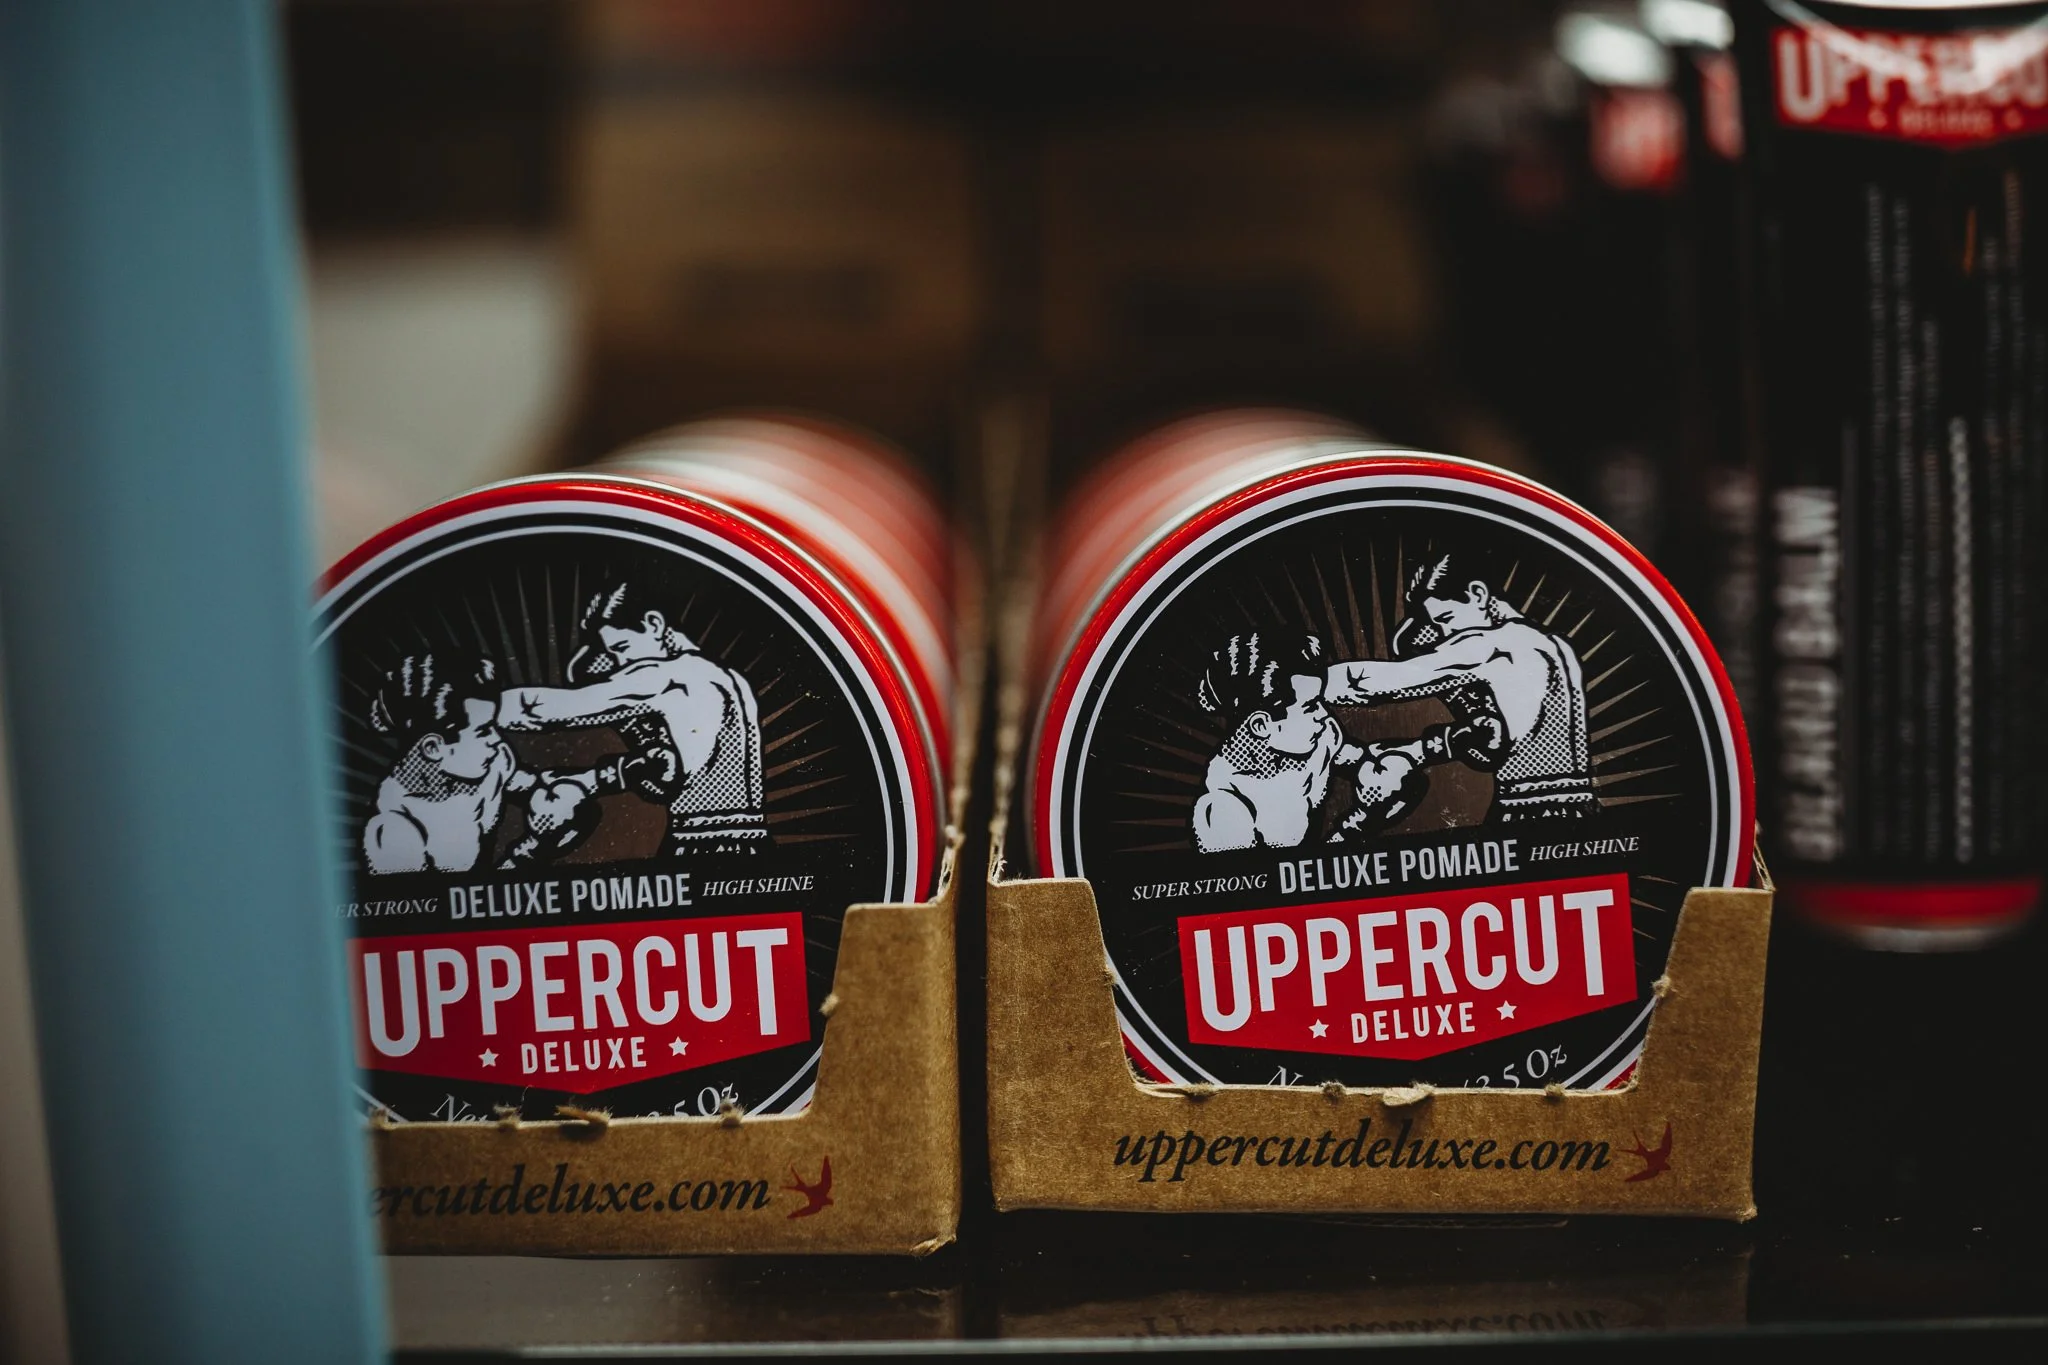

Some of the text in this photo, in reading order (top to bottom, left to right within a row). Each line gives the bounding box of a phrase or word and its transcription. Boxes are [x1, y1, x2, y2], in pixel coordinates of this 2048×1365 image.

[1279, 839, 1519, 894] DELUXE POMADE
[1530, 837, 1640, 862] HIGH SHINE
[449, 873, 693, 919] DELUXE POMADE
[702, 875, 814, 897] HIGH SHINE
[1132, 874, 1268, 901] SUPER STRONG
[363, 898, 438, 917] STRONG
[1193, 889, 1614, 1032] UPPERCUT
[363, 928, 789, 1057] UPPERCUT
[1351, 1002, 1476, 1044] DELUXE
[521, 1036, 647, 1074] DELUXE
[1526, 1044, 1567, 1079] Oz
[697, 1083, 739, 1117] Oz
[1113, 1118, 1610, 1184] uppercutdeluxe.com
[370, 1163, 770, 1217] ercutdeluxe.com
